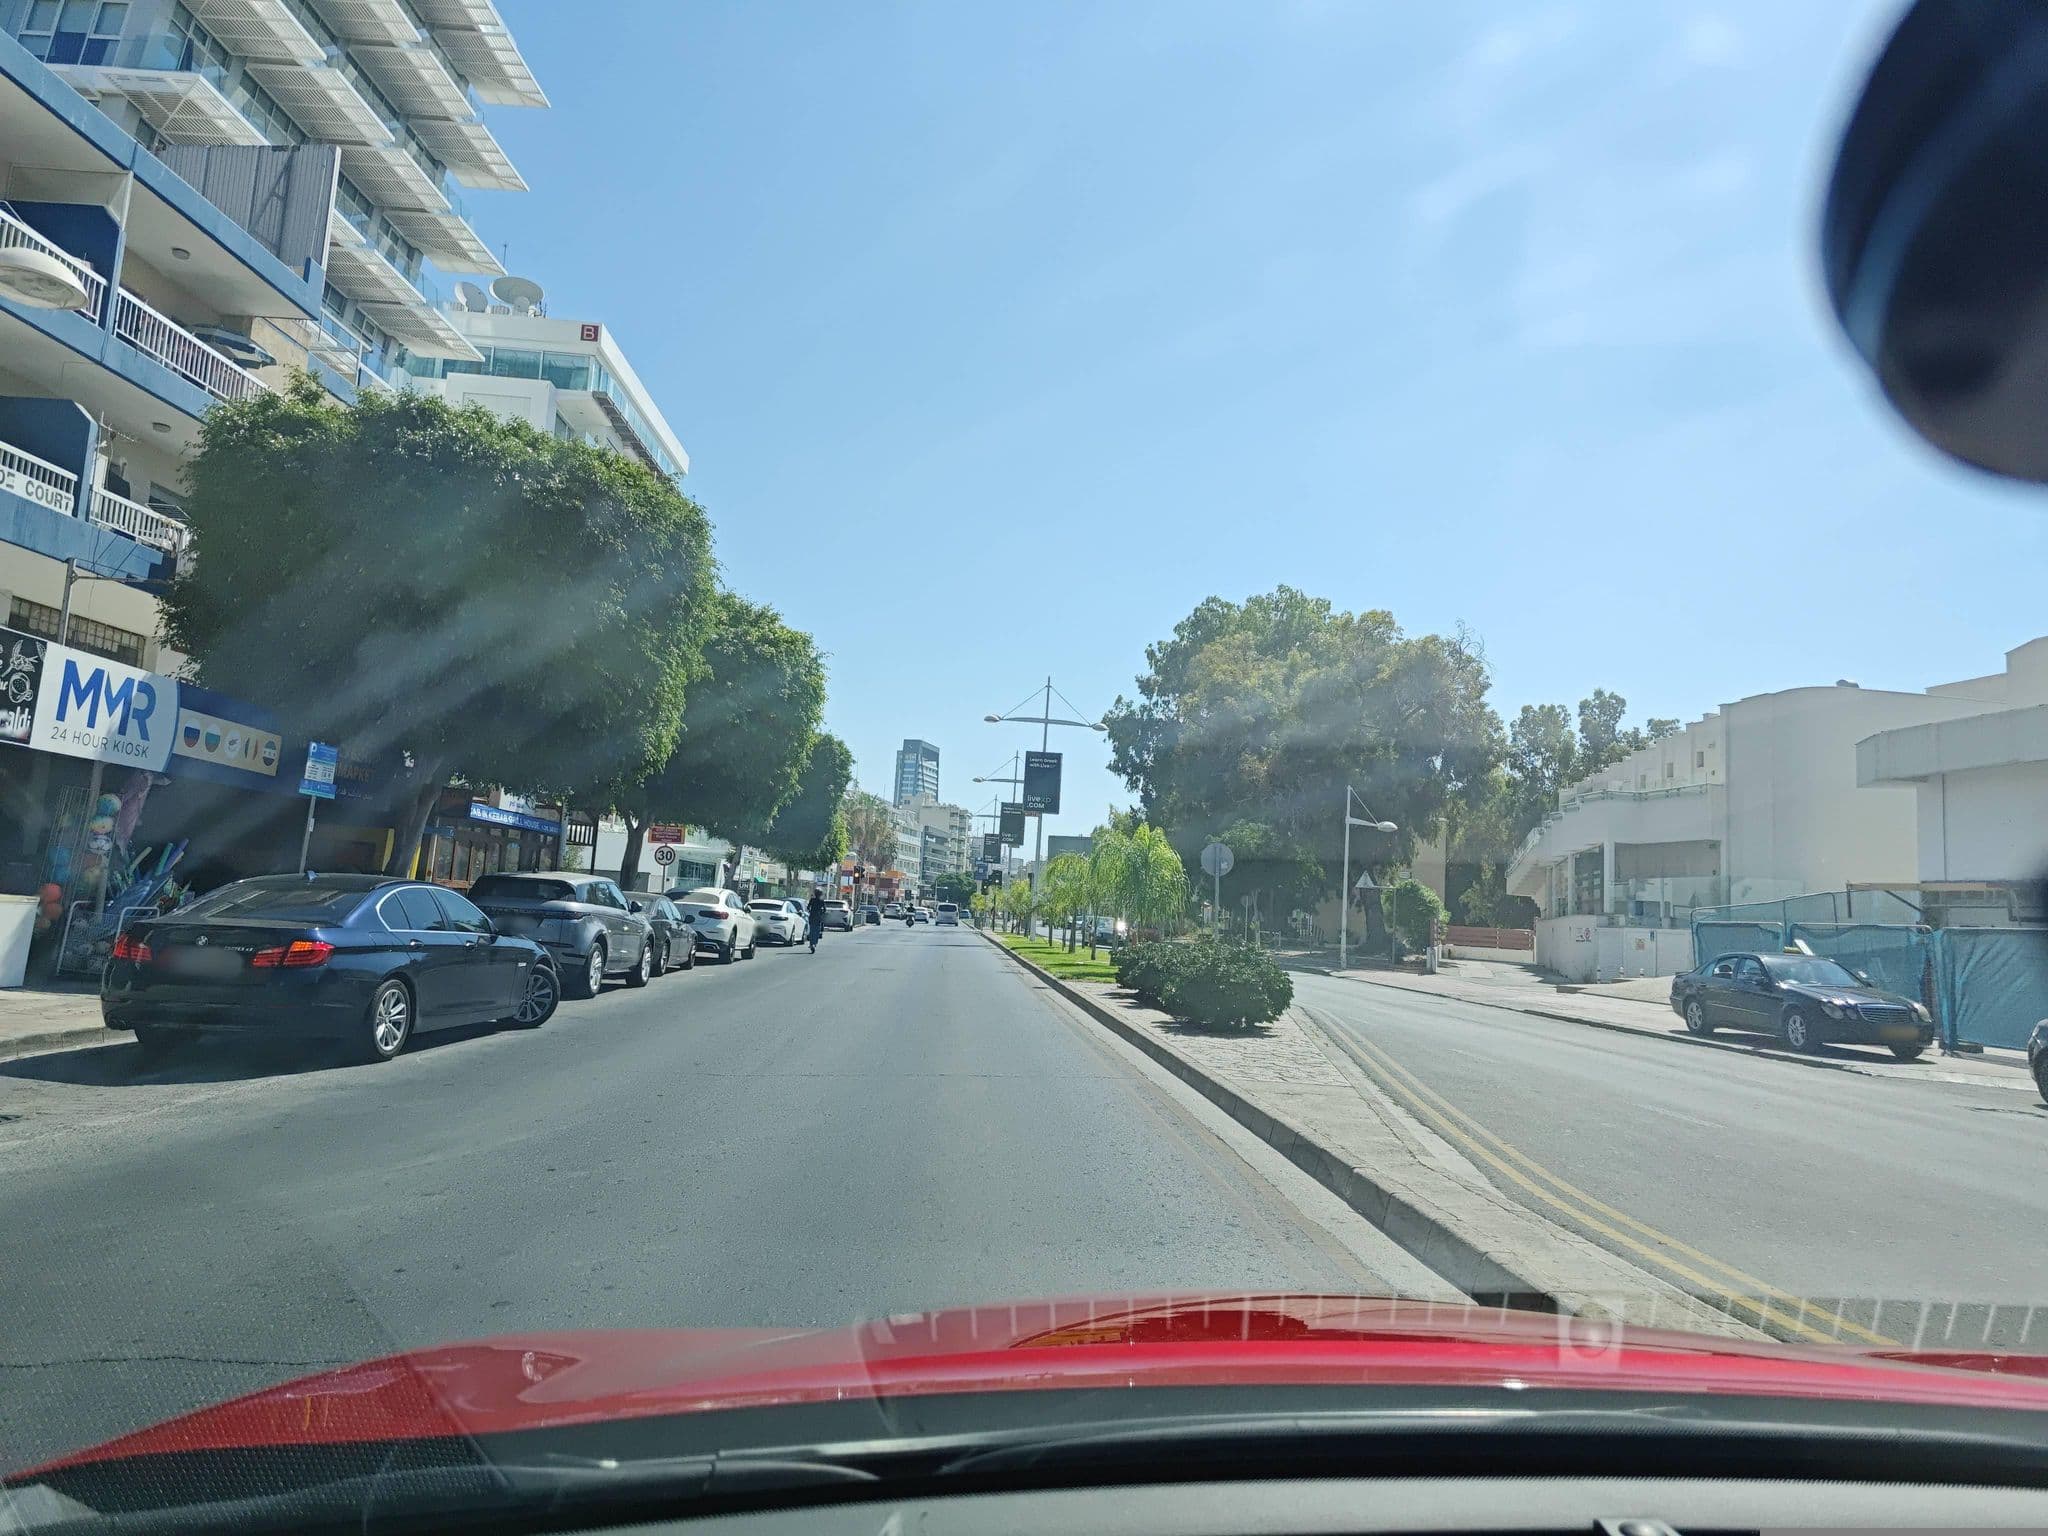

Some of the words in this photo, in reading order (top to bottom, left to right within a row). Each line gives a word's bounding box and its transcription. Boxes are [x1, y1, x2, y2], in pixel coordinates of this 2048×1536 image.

[583, 326, 595, 340] B
[25, 480, 72, 511] COURT
[55, 658, 157, 742] MMR
[51, 726, 67, 740] 24
[72, 731, 109, 752] HOUR
[112, 740, 150, 759] KIOSK
[657, 850, 673, 861] 30
